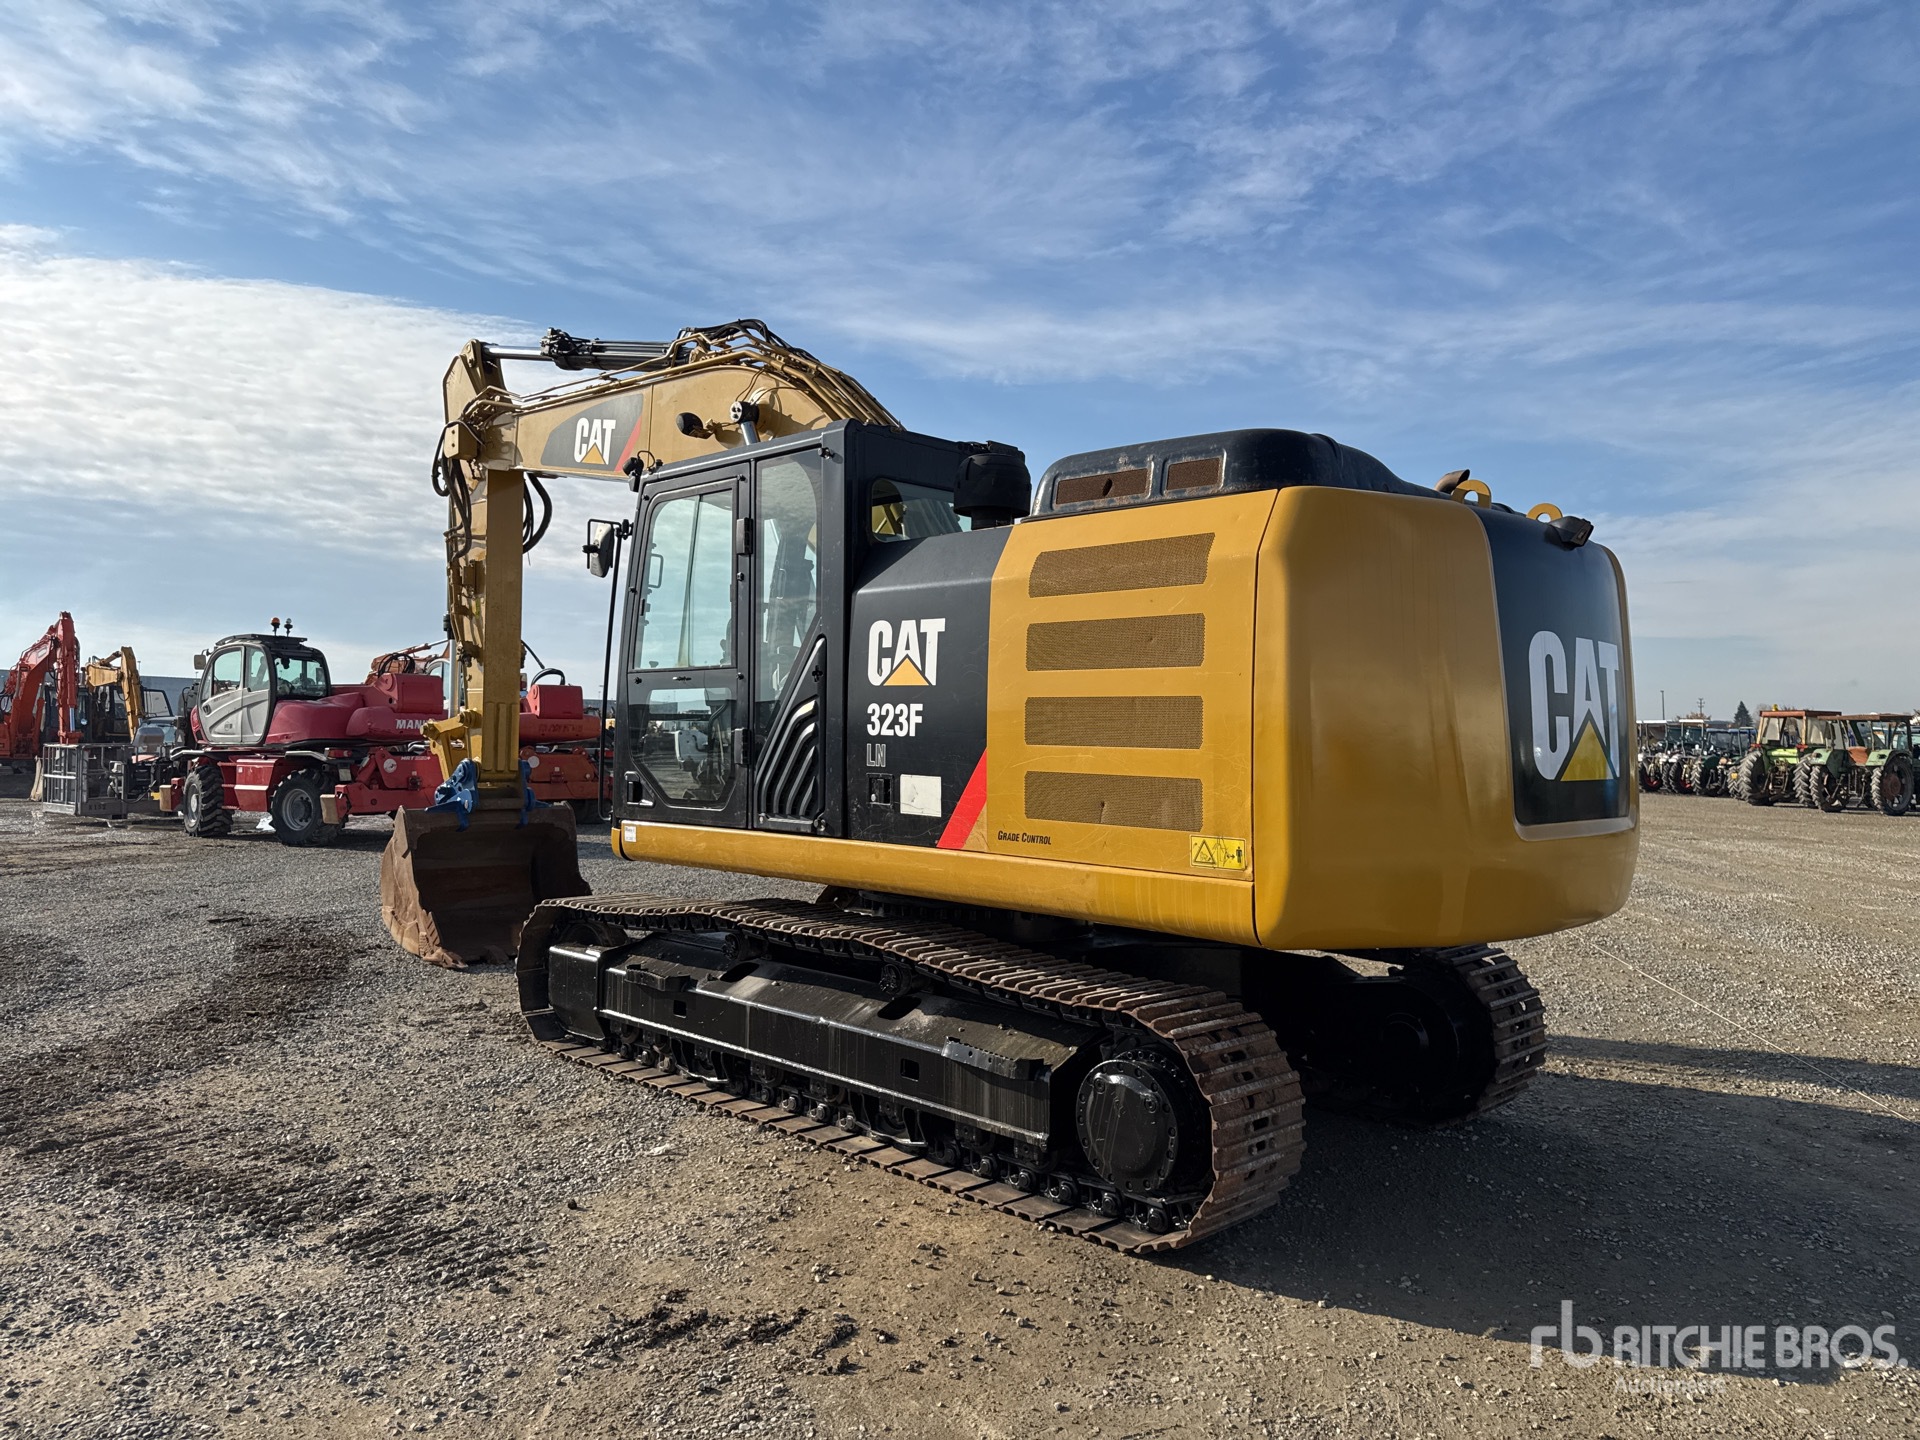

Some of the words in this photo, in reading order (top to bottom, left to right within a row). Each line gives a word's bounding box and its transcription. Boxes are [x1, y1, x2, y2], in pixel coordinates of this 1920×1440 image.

[574, 417, 616, 465] CAT
[868, 618, 946, 686] CAT
[867, 703, 923, 737] 323F
[1529, 631, 1620, 781] CAT
[866, 743, 886, 768] LN
[997, 830, 1020, 842] GRADE
[1021, 832, 1052, 845] CONTROL
